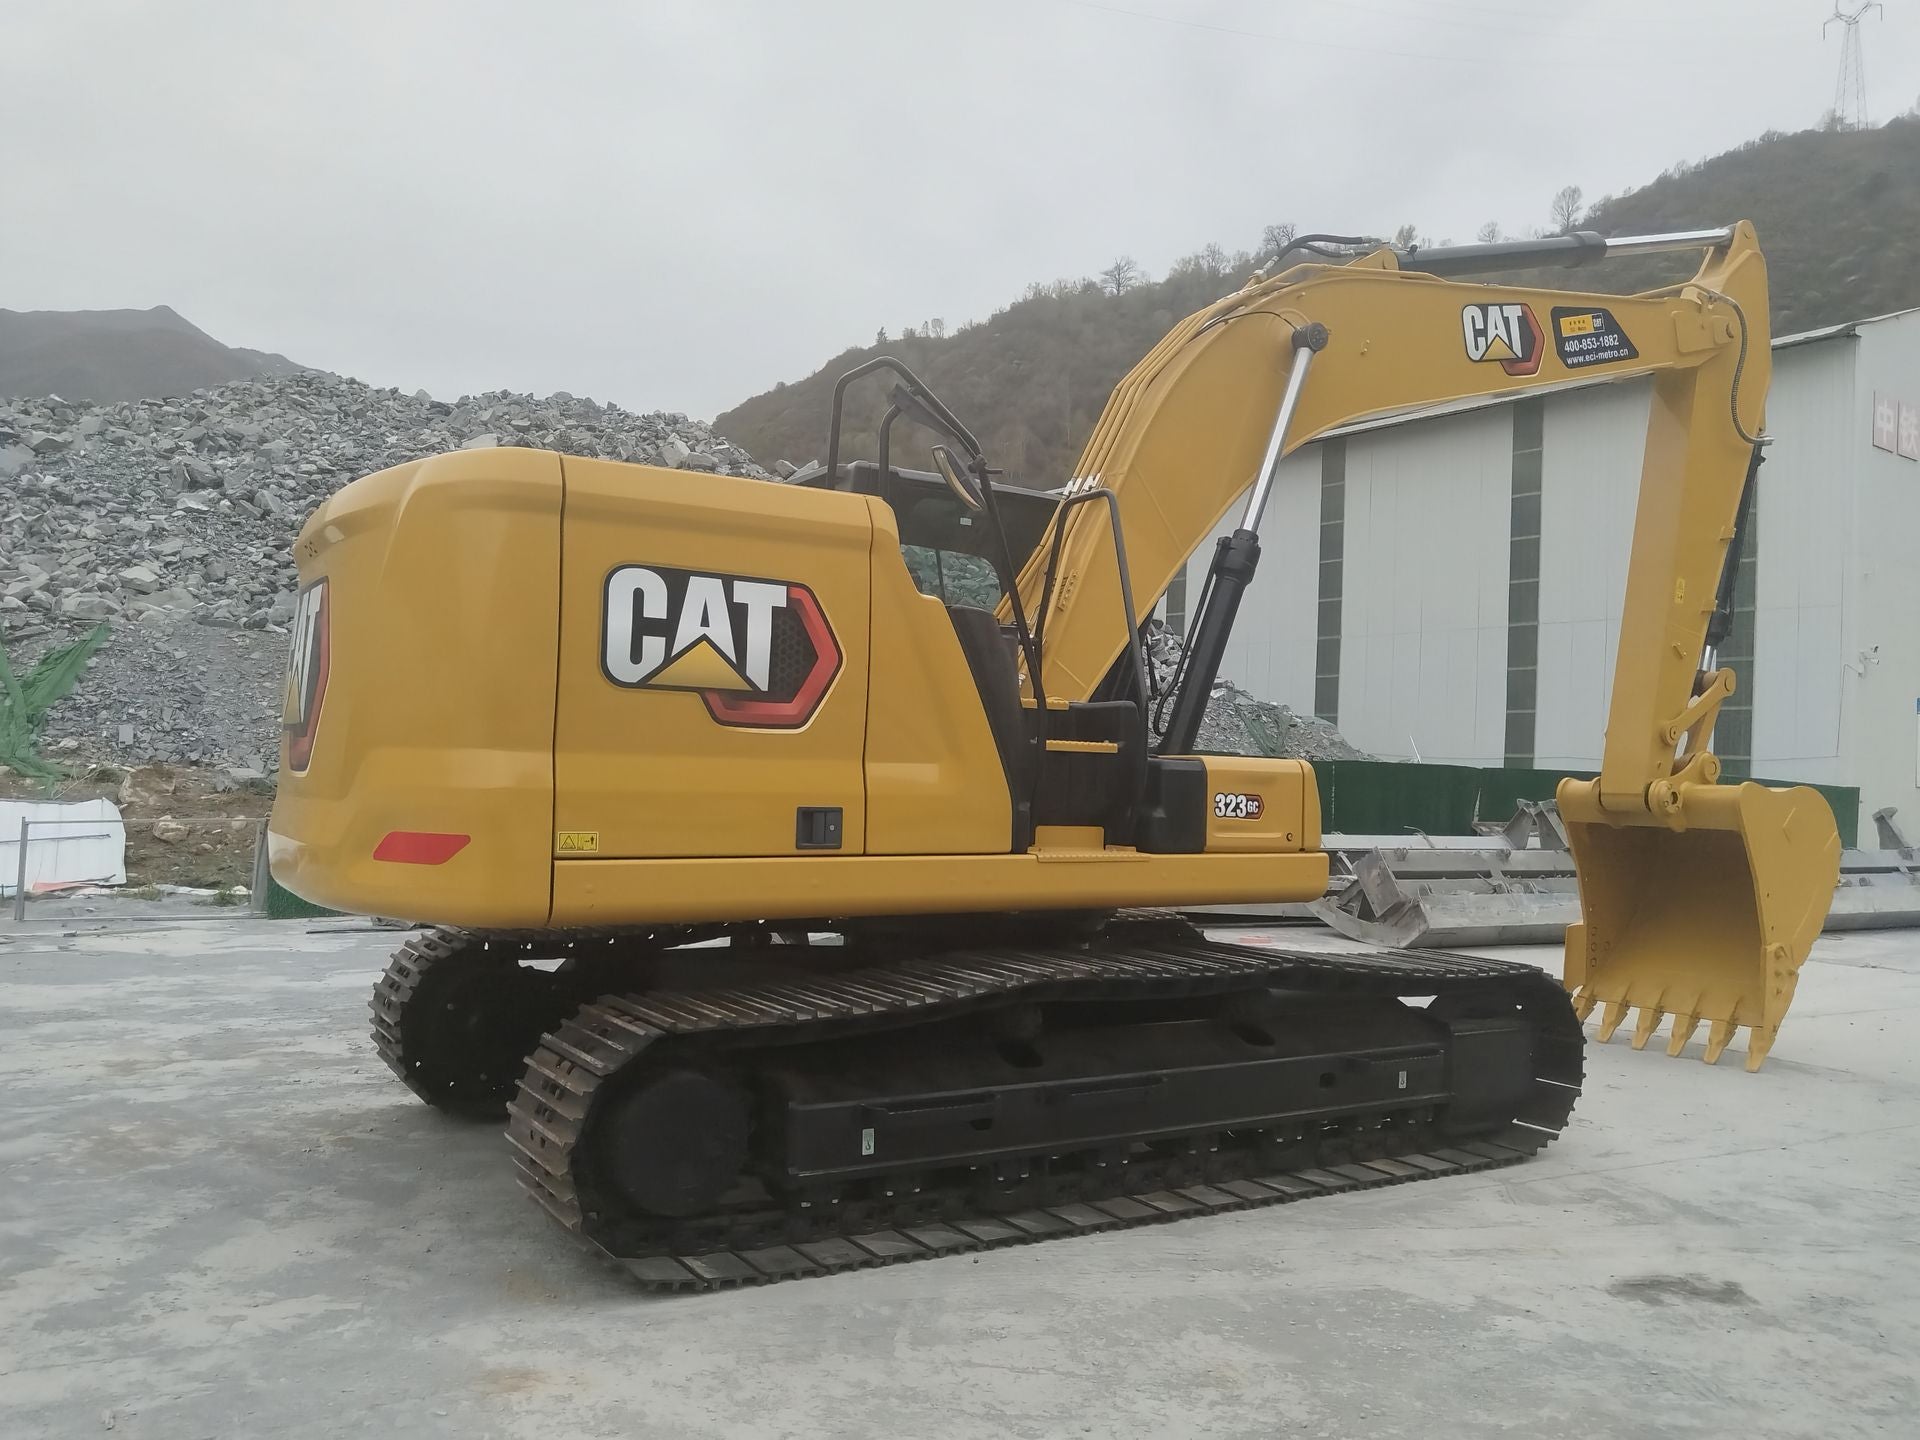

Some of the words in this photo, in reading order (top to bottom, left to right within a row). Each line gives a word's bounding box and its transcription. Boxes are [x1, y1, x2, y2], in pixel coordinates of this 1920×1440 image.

[1462, 304, 1522, 361] CAT
[1564, 334, 1619, 353] 400-853-1882
[1566, 348, 1629, 365] www.eci-metro.cn
[606, 567, 788, 692] CAT
[287, 583, 323, 723] AT
[1215, 793, 1247, 818] 323
